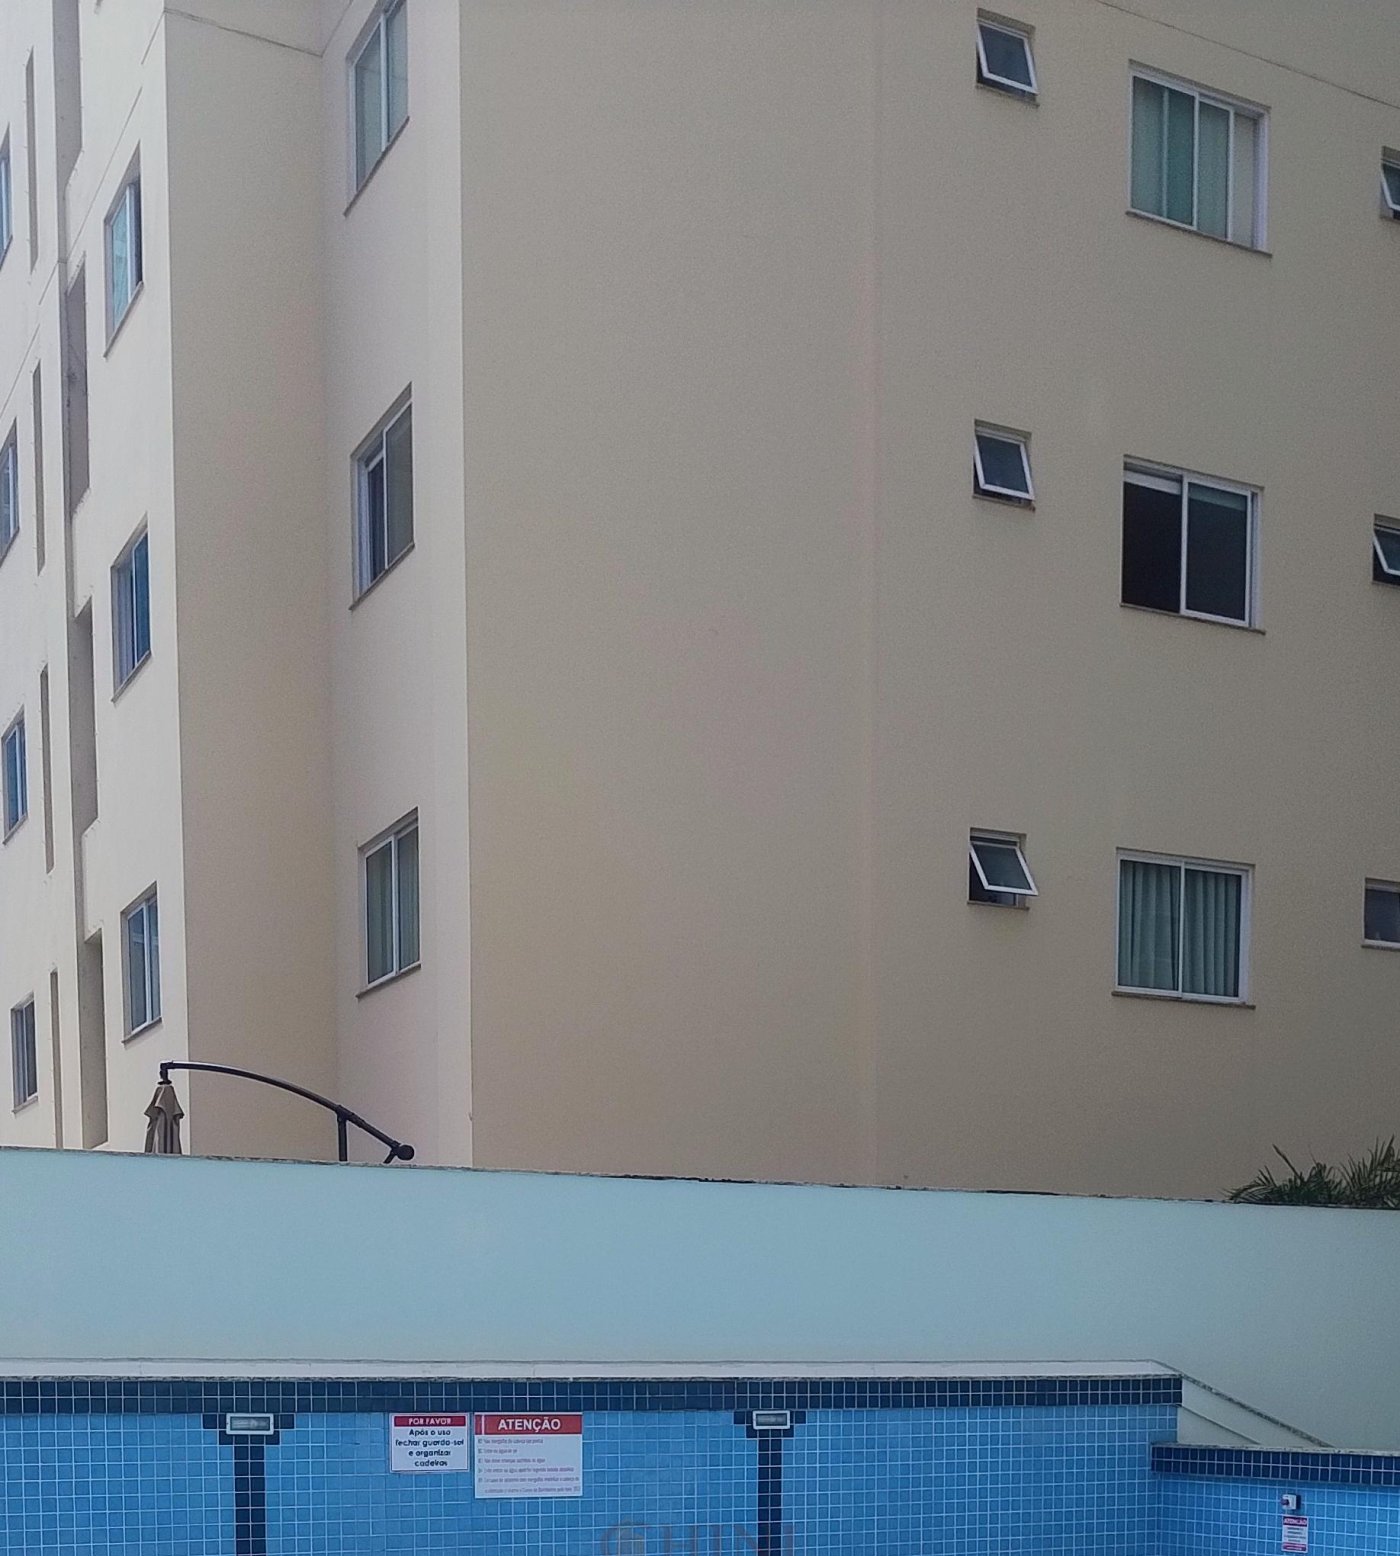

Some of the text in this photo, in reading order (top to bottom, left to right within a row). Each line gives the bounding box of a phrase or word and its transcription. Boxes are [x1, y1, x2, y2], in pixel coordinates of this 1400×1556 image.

[498, 1417, 561, 1432] ATENÇÃO
[408, 1428, 428, 1436] Após
[422, 1439, 464, 1447] guarda-sol
[415, 1449, 451, 1457] organizar
[414, 1459, 448, 1467] cadeiras
